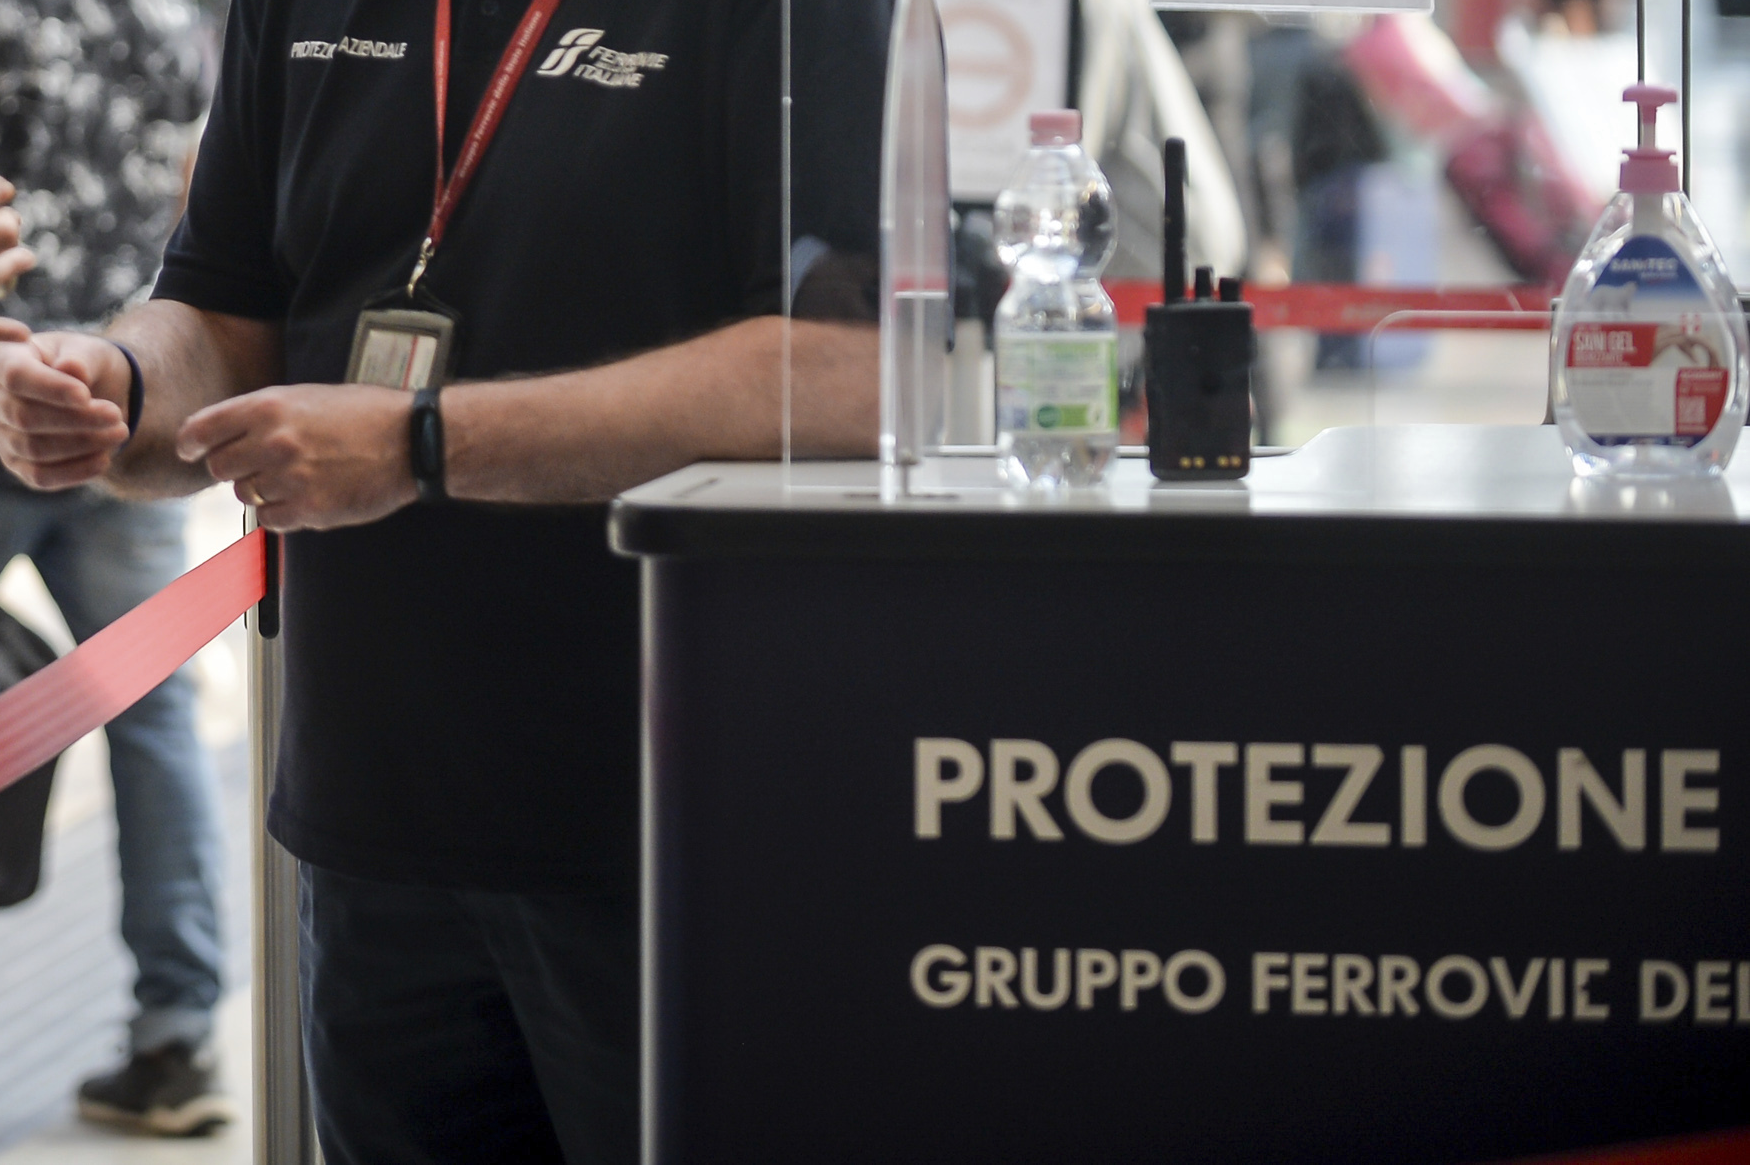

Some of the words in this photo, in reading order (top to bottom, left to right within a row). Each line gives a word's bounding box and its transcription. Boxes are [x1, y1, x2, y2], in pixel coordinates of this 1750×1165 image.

[913, 736, 1721, 853] PROTEZIONE
[910, 943, 1227, 1015] GRUPPO
[1252, 951, 1611, 1020] FERROVIE
